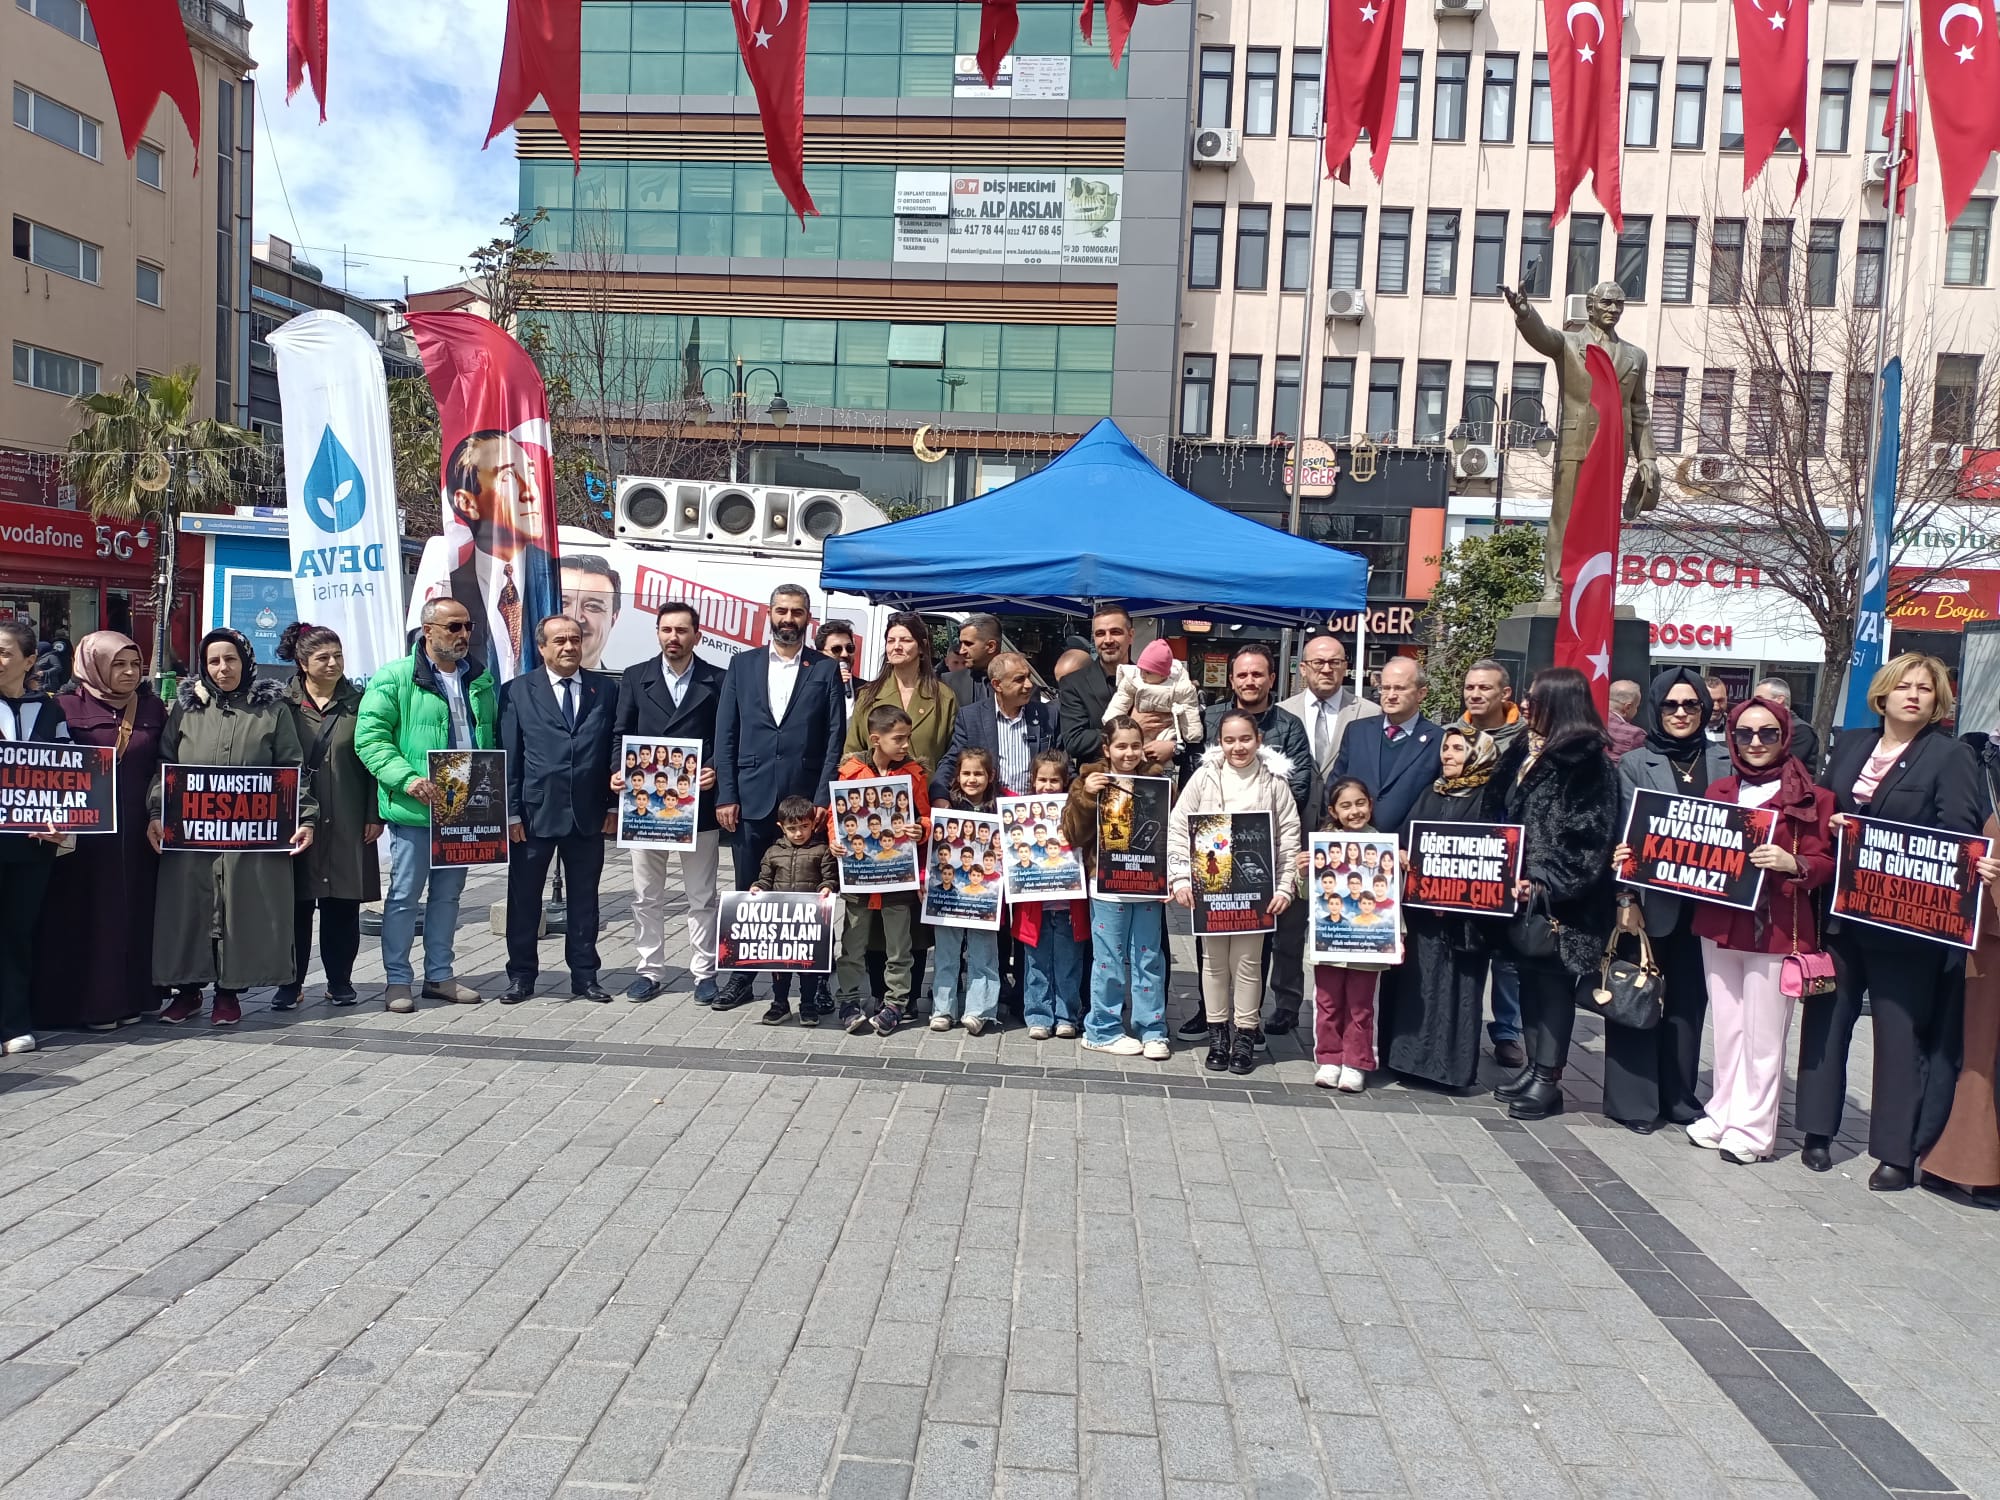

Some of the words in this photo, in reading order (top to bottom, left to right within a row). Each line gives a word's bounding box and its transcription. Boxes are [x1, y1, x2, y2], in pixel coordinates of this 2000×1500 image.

[983, 180, 1006, 194] DİŞ
[1009, 180, 1056, 193] HEKİMİ
[980, 201, 1005, 218] ALP
[1009, 201, 1063, 219] ARSLAN
[964, 225, 979, 235] 417
[982, 225, 992, 235] 78
[994, 225, 1004, 235] 44
[1022, 225, 1037, 236] 417
[1039, 225, 1050, 236] 68
[1051, 225, 1062, 236] 45
[1072, 245, 1080, 253] 3D
[1284, 467, 1336, 485] BRGER
[1, 525, 83, 549] vodafone
[96, 526, 133, 560] 5G
[1622, 555, 1760, 589] BOSCH
[641, 570, 760, 641] MAHMUT
[1935, 595, 1989, 624] Boyu
[2, 764, 91, 790] LÜRKEN
[187, 773, 204, 791] BU
[209, 772, 272, 794] VAHŞETİN
[0, 789, 87, 808] USANLAR
[182, 792, 277, 820] HESABI
[12, 806, 99, 824] ORTAĞIDIR!
[1667, 800, 1729, 828] EĞİTİM
[183, 820, 278, 841] VERİLMELİ!
[1649, 815, 1743, 850] YUVASINDA
[1420, 832, 1508, 860] ÖĞRETMENİNE,
[1864, 823, 1905, 853] İHMAL
[1908, 835, 1960, 863] EDİLEN
[446, 849, 496, 862] OLDULAR!
[1111, 853, 1156, 864] SALINCAKLARDA
[1642, 834, 1746, 876] KATLIAM
[1422, 853, 1504, 881] ÖĞRENCİNE
[1656, 861, 1728, 892] OLMAZ!
[1858, 847, 1883, 871] BİR
[1885, 853, 1961, 890] GÜVENLİK,
[1420, 877, 1467, 901] SAHİP
[1470, 880, 1504, 908] ÇIK!
[1861, 871, 1886, 896] YOK
[1890, 878, 1954, 912] SAYILAN
[736, 902, 817, 923] OKULLAR
[1207, 910, 1257, 921] TABUTLARA
[1210, 901, 1251, 911] ÇOCUKLAR
[1849, 891, 1867, 912] BİR
[1870, 896, 1894, 919] CAN
[1896, 903, 1965, 936] DEMEKTİR!
[731, 923, 777, 943] SAVAŞ
[780, 924, 821, 941] ALANI
[1206, 920, 1260, 932] KONULUYOR!
[738, 941, 814, 960] DEĞİLDİR!
